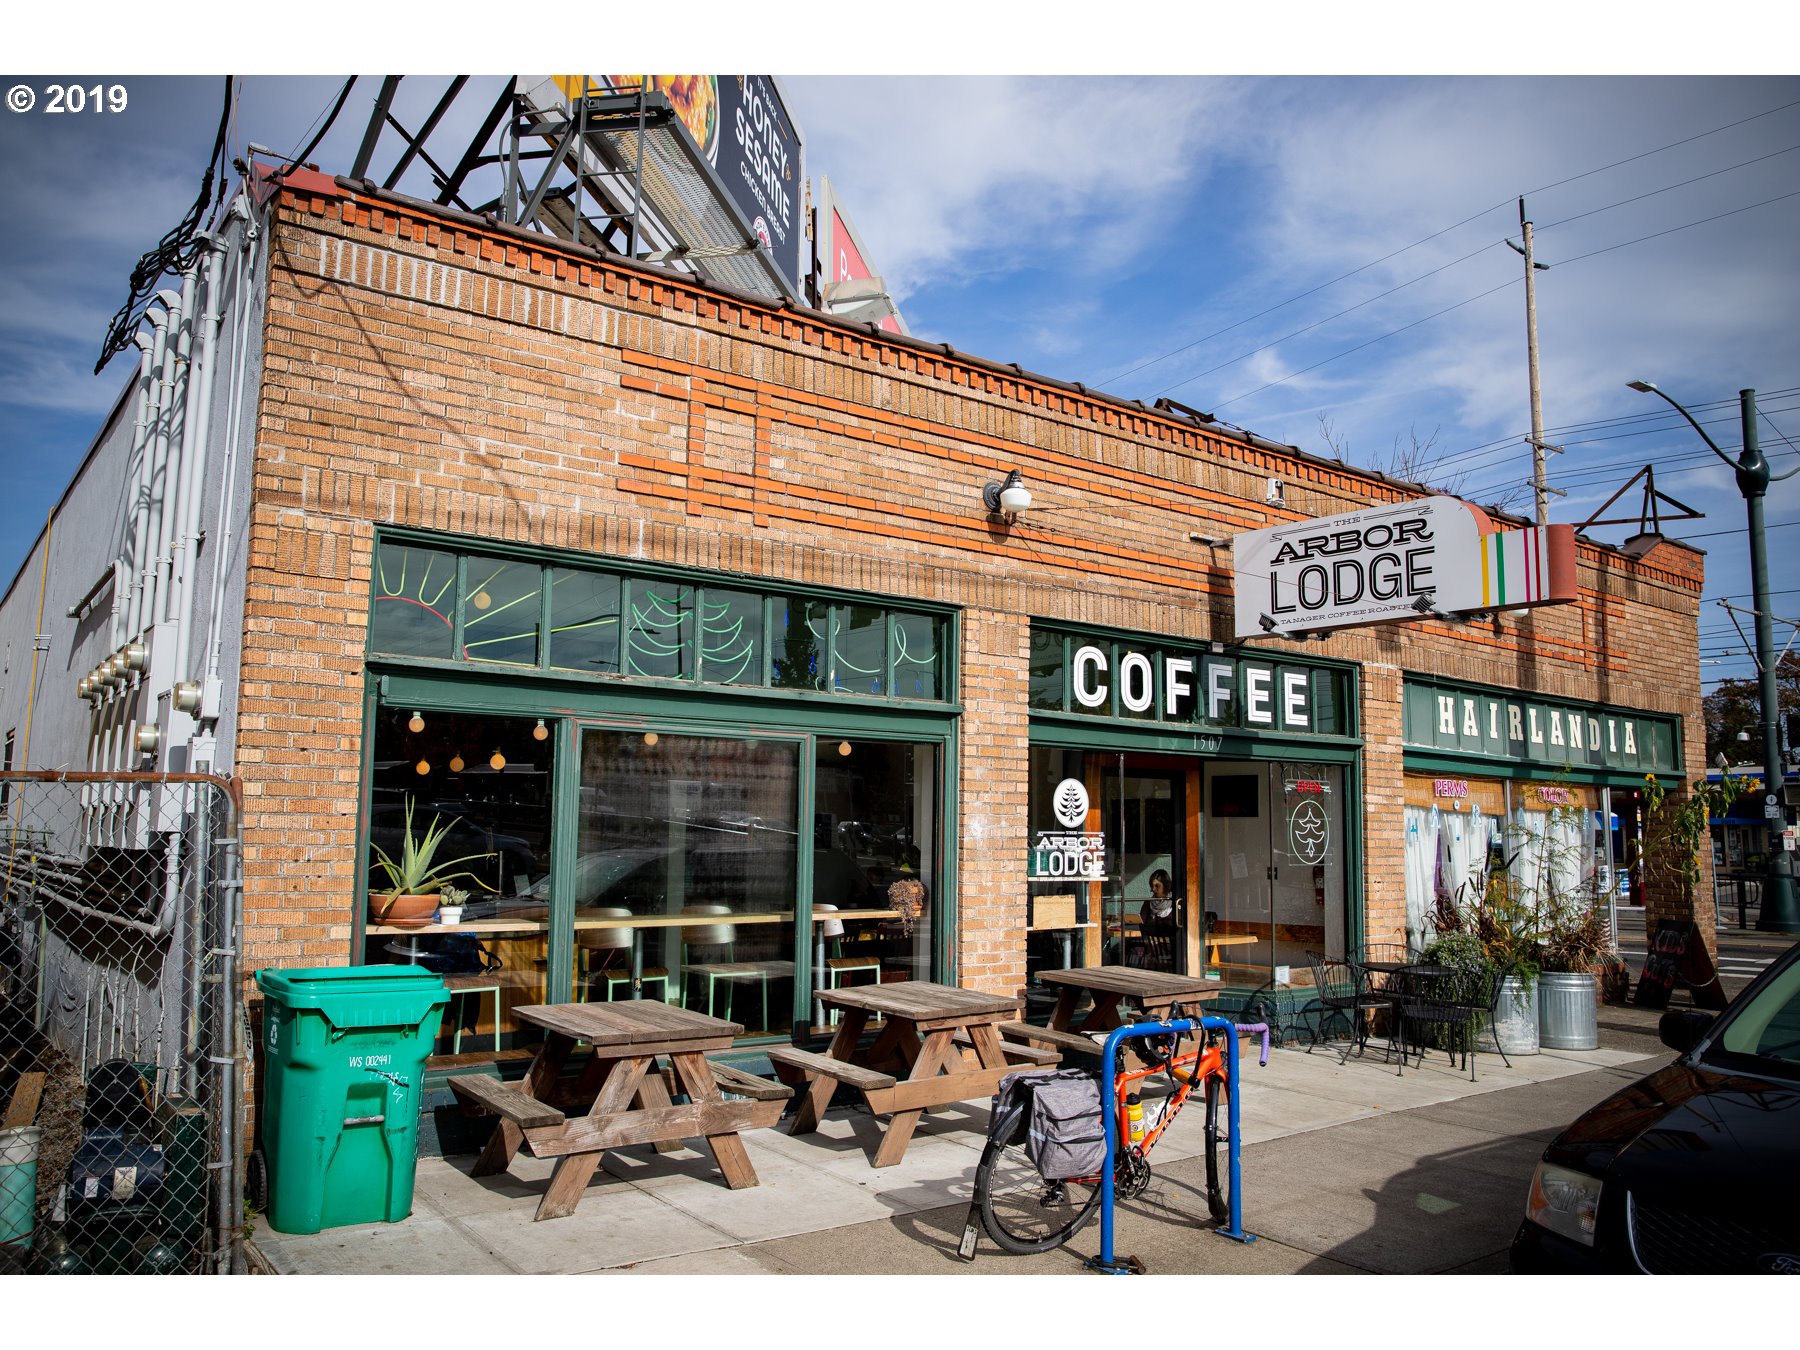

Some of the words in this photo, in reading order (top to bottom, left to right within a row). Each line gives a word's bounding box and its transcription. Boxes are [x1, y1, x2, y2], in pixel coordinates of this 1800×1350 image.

[766, 93, 777, 122] BACK
[766, 203, 786, 245] BREAST
[1334, 516, 1361, 527] THE
[1270, 518, 1434, 566] ARBOR
[1270, 545, 1437, 615] LODGE
[1281, 614, 1326, 625] TANAGER
[1327, 609, 1367, 619] COFFEE
[1073, 646, 1309, 726] COFFEE
[1438, 695, 1637, 754] HAIRLANDIA
[1192, 734, 1223, 751] 1507
[1297, 780, 1321, 793] OPEN
[1434, 779, 1469, 798] PERMS
[1036, 836, 1105, 850] ARBOR
[1036, 851, 1105, 876] LODGE
[349, 1056, 363, 1068] WS
